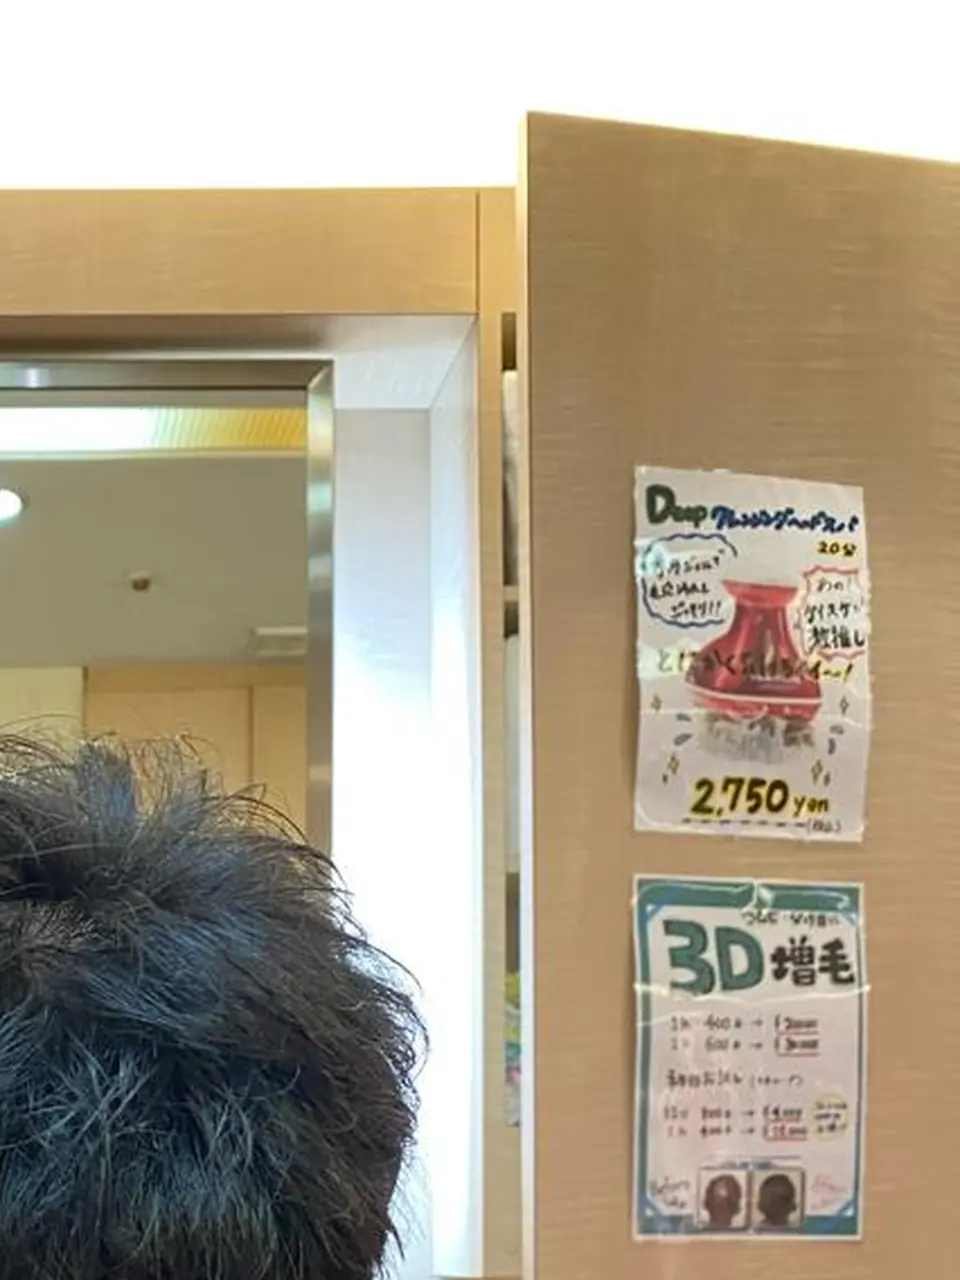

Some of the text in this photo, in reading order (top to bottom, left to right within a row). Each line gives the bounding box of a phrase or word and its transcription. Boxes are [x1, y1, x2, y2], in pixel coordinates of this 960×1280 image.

[645, 483, 709, 529] Deep
[690, 776, 829, 818] 2,750 yen
[662, 918, 857, 995] 3D 増毛
